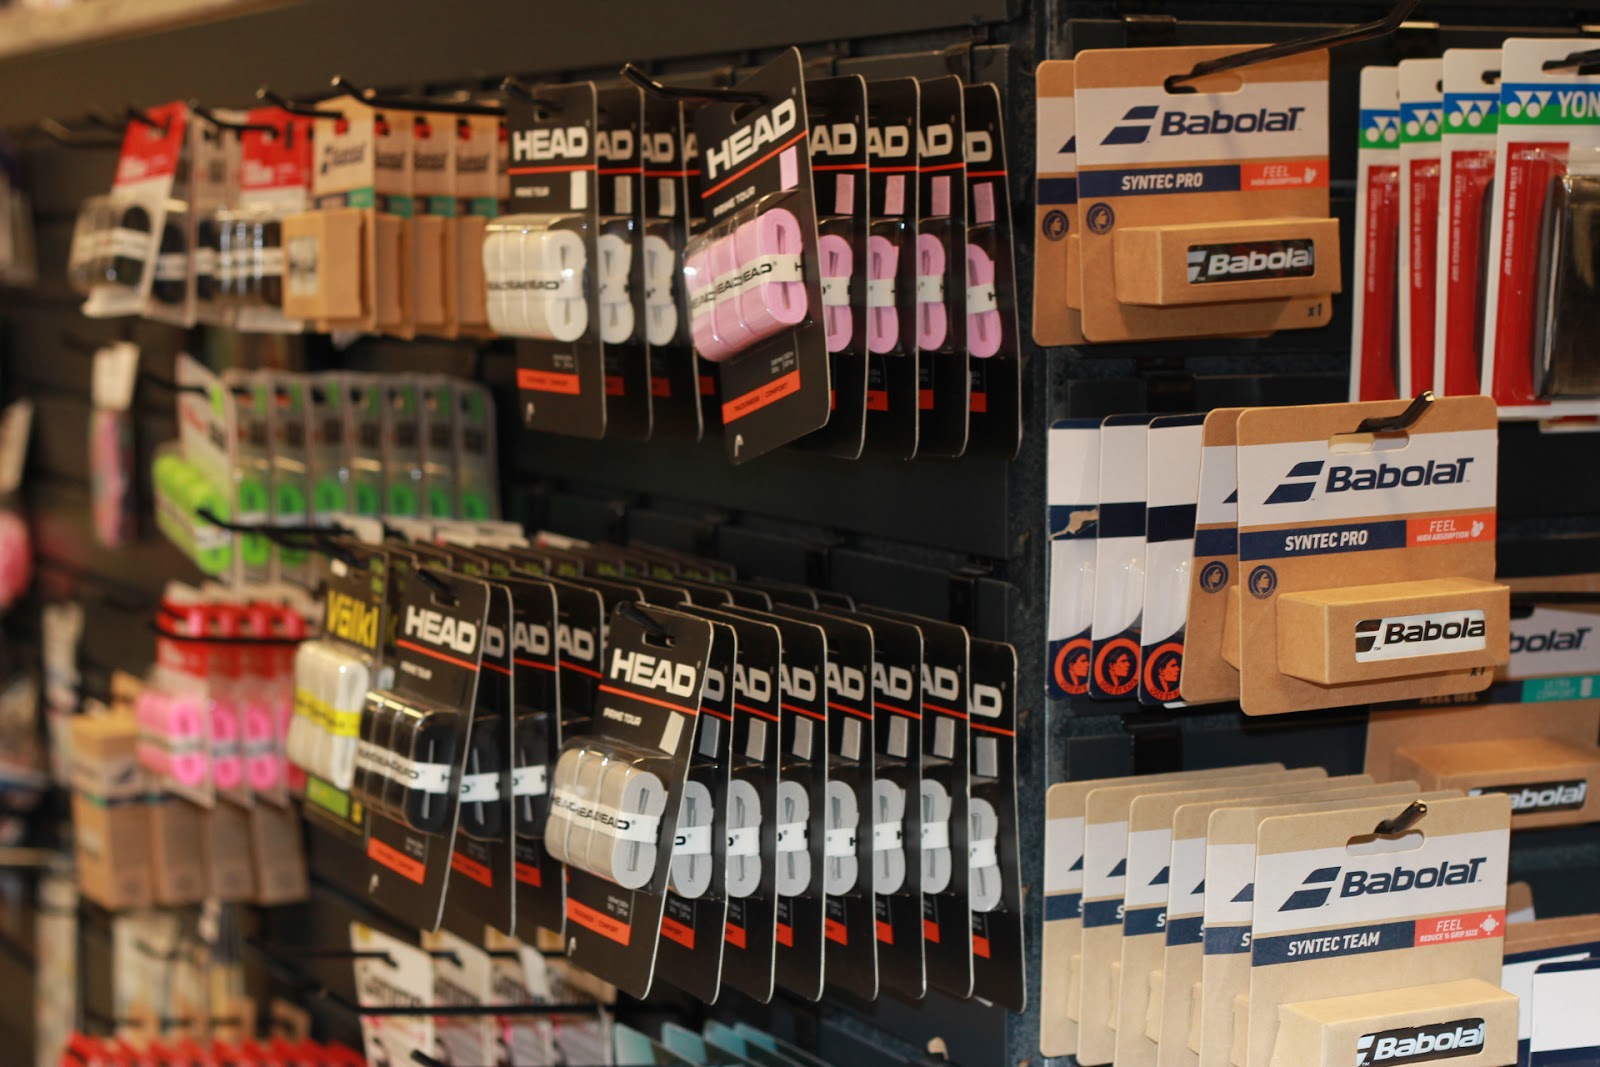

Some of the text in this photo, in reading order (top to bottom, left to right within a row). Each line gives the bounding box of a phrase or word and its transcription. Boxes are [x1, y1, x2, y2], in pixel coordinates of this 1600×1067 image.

[513, 127, 589, 161] HEAD
[706, 98, 796, 180] HEAD
[1121, 172, 1203, 191] SYNTEC PRO
[1263, 166, 1290, 177] FEEL
[1430, 520, 1456, 533] FEEL
[1432, 531, 1469, 542] ABSORPTION
[1285, 530, 1368, 551] SYNTEC PRO
[405, 605, 477, 654] HEAD
[610, 648, 696, 698] HEAD
[1436, 919, 1462, 932] FEEL
[1287, 931, 1381, 957] SYNTEC TEAM
[1420, 933, 1443, 943] REDUCE
[1451, 931, 1465, 939] GRIP
[1465, 929, 1478, 937] SIZE
